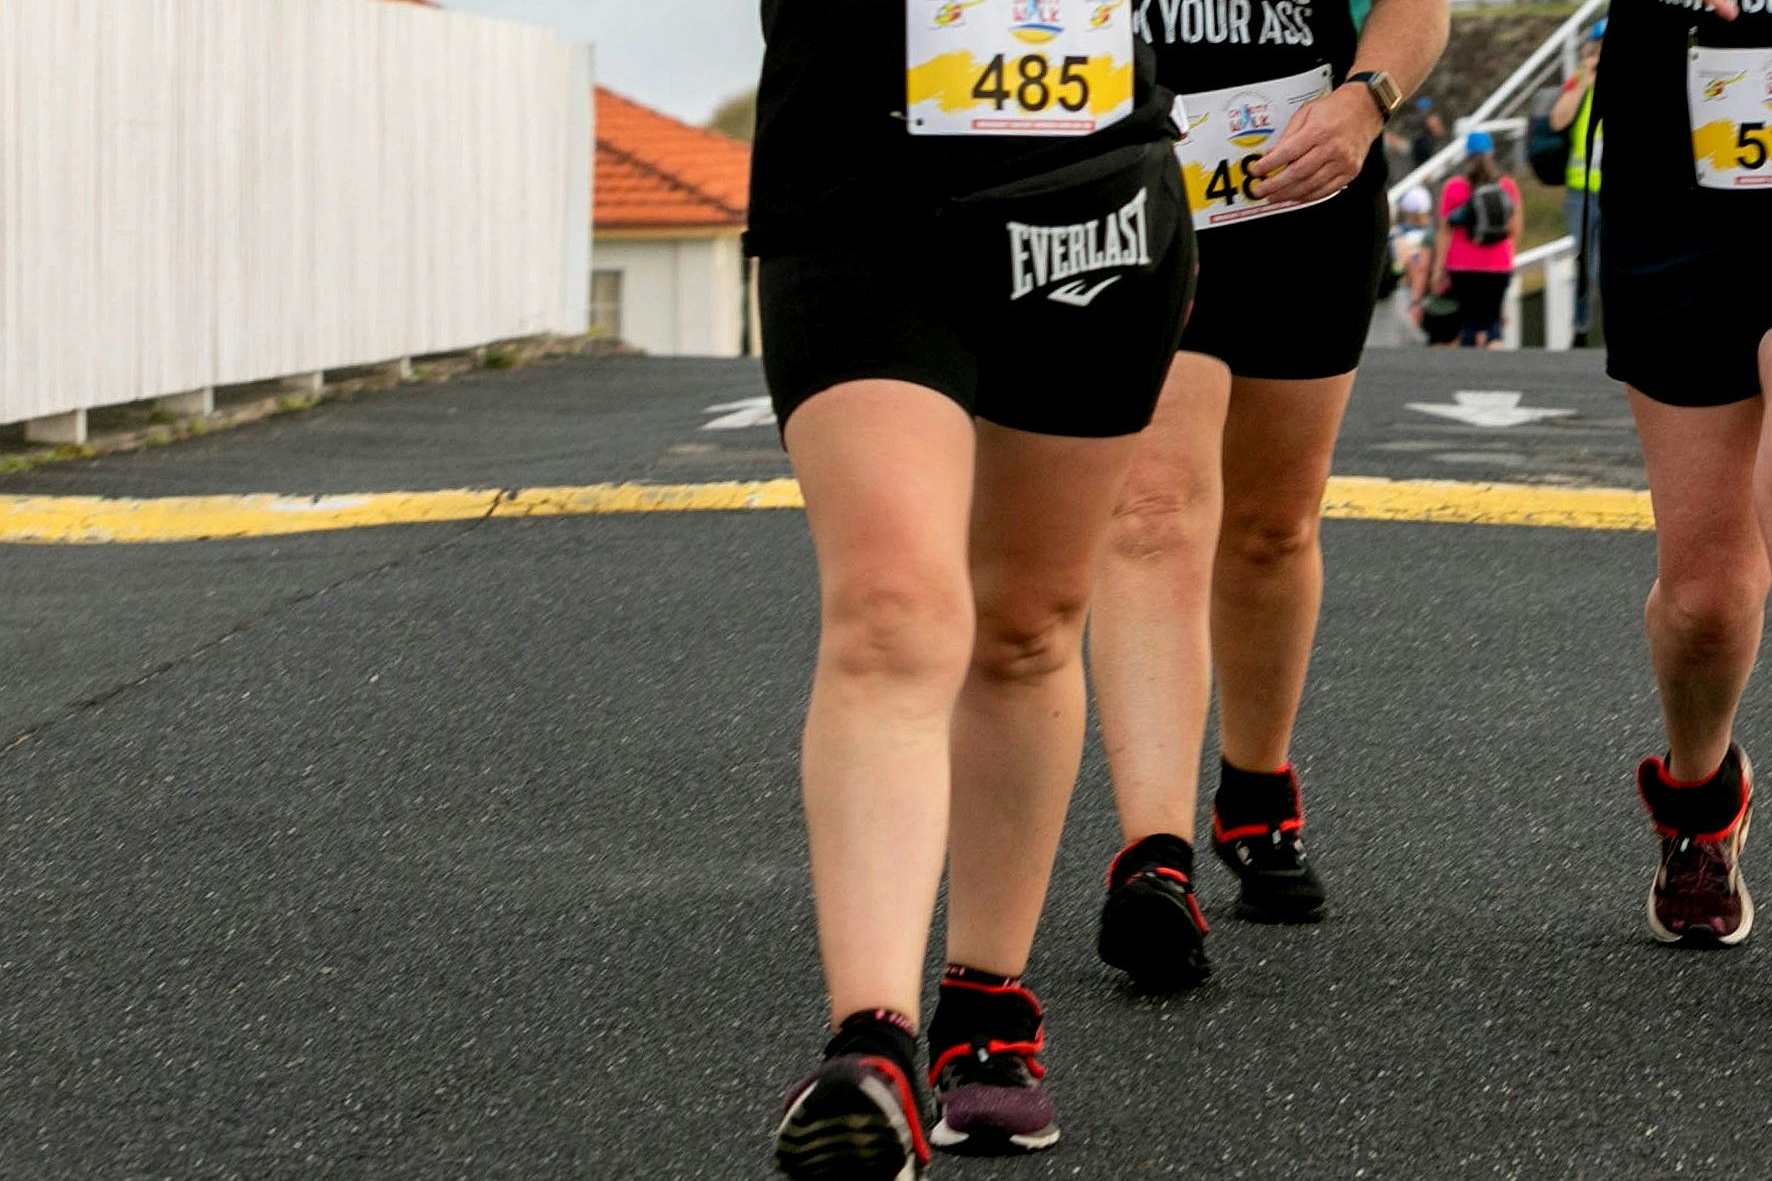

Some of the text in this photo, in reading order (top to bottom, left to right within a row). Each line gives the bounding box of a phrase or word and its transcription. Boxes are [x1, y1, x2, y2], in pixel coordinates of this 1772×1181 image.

[1258, 0, 1315, 48] ASS
[971, 52, 1089, 112] 485
[1006, 186, 1152, 301] EVERLAST
